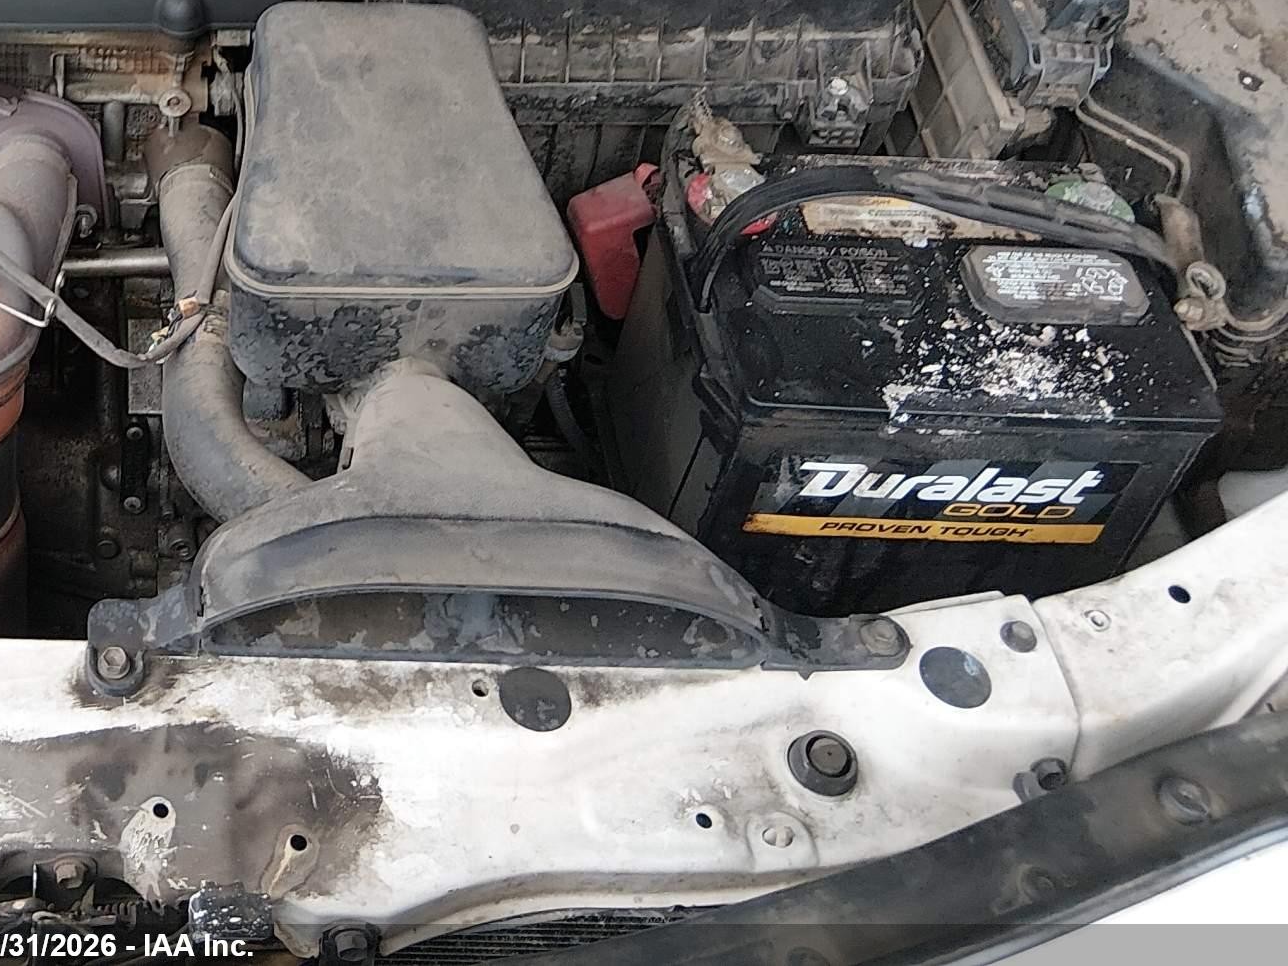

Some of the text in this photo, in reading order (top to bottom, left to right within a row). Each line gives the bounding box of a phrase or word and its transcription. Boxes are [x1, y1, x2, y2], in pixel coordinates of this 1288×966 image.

[775, 244, 830, 256] DANGER
[799, 461, 1102, 504] Duralast
[942, 503, 1076, 519] GOLD
[819, 522, 1028, 539] PROVEN TOUGH
